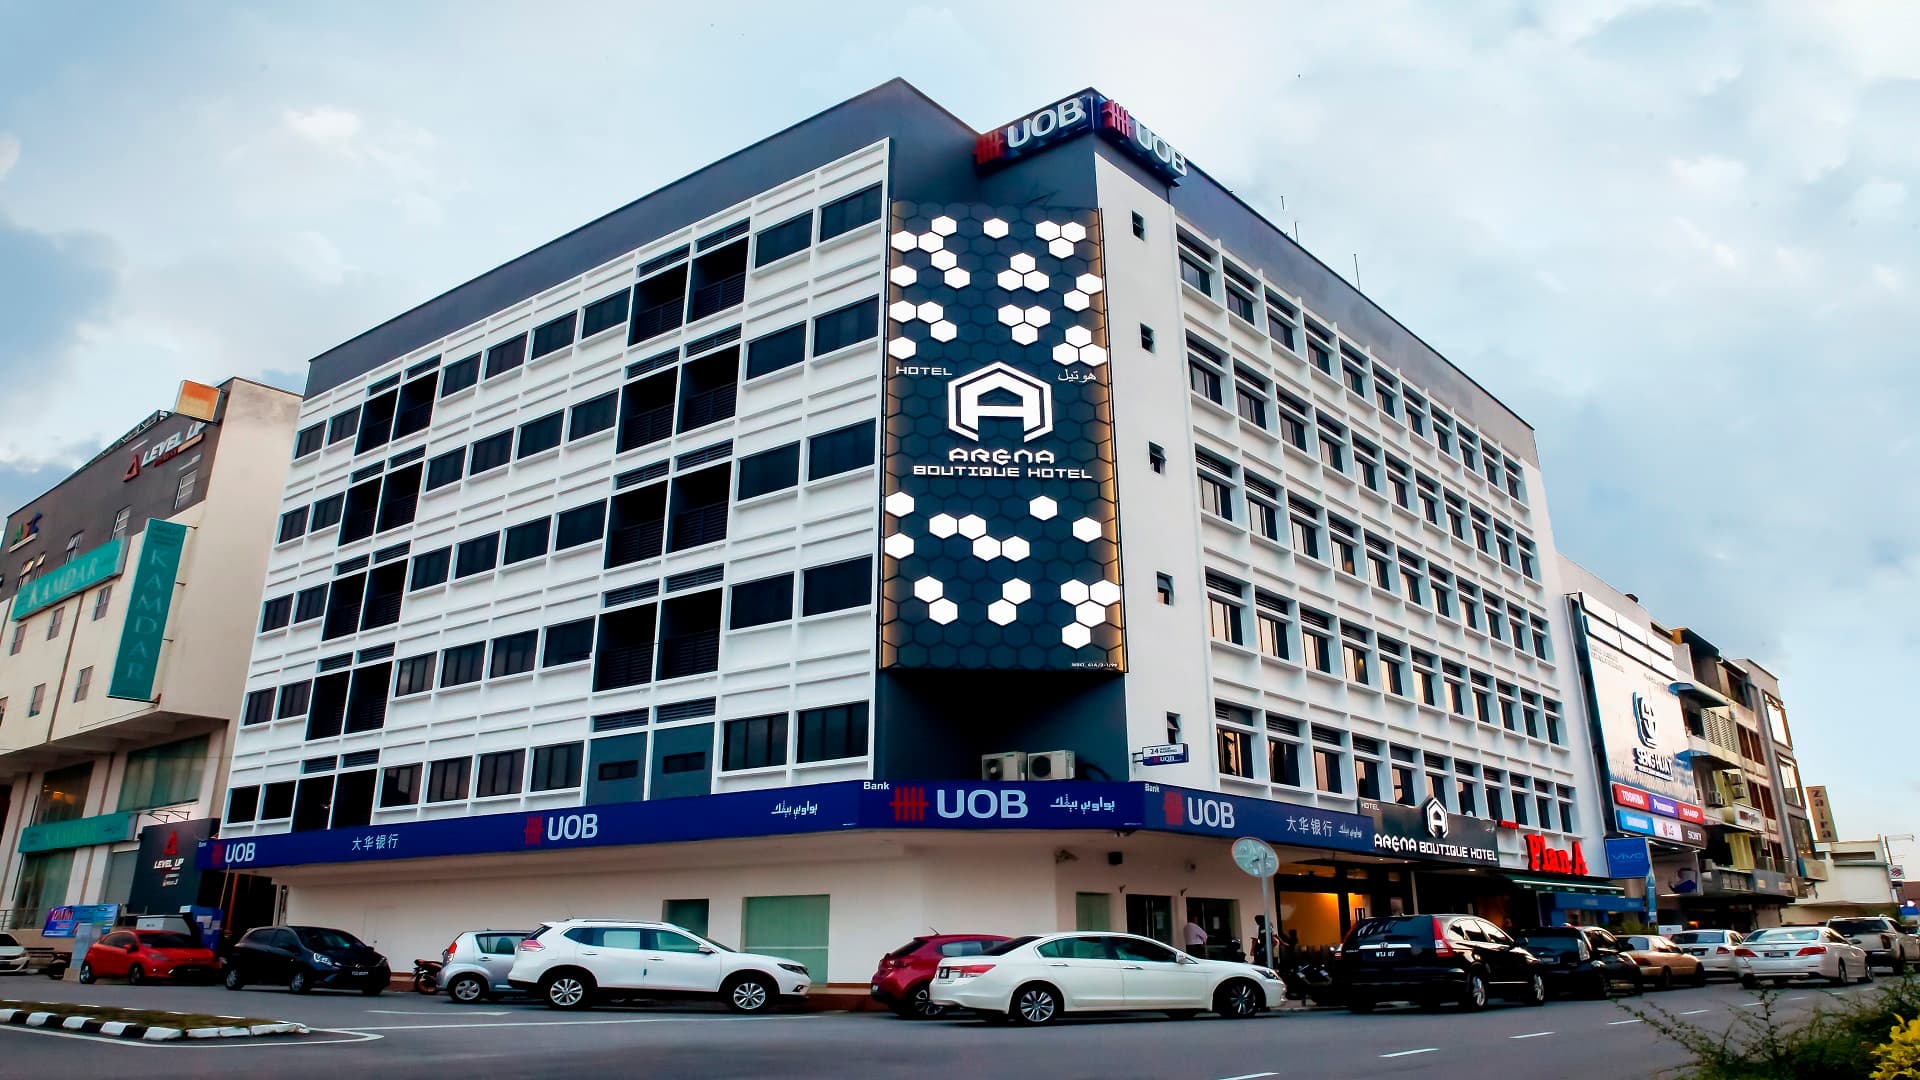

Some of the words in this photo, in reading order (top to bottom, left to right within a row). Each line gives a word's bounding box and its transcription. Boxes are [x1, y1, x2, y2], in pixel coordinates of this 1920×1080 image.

[1007, 97, 1086, 148] UOB
[1135, 119, 1187, 176] UOB
[896, 366, 952, 376] HOTEL
[141, 431, 183, 468] LEVEL
[949, 448, 1055, 465] ARENA
[913, 465, 1020, 478] BOUTIQUE
[1027, 468, 1092, 479] HOTEL
[127, 549, 167, 680] KAMDAR
[863, 781, 890, 790] Bank
[1145, 783, 1160, 793] Bank
[937, 789, 1029, 819] UOB
[1187, 797, 1235, 829] UOB
[1361, 802, 1380, 811] HOTEL
[548, 814, 598, 841] UOB
[1286, 815, 1333, 838] 大华银行
[225, 842, 256, 863] UOB
[352, 833, 399, 851] 大华银行
[1374, 833, 1417, 852] ARENA
[1419, 841, 1468, 858] BOUTIQUE
[1470, 847, 1498, 861] HOTEL
[1524, 833, 1571, 874] Plan
[153, 859, 172, 869] LEVEL
[174, 857, 184, 867] UP
